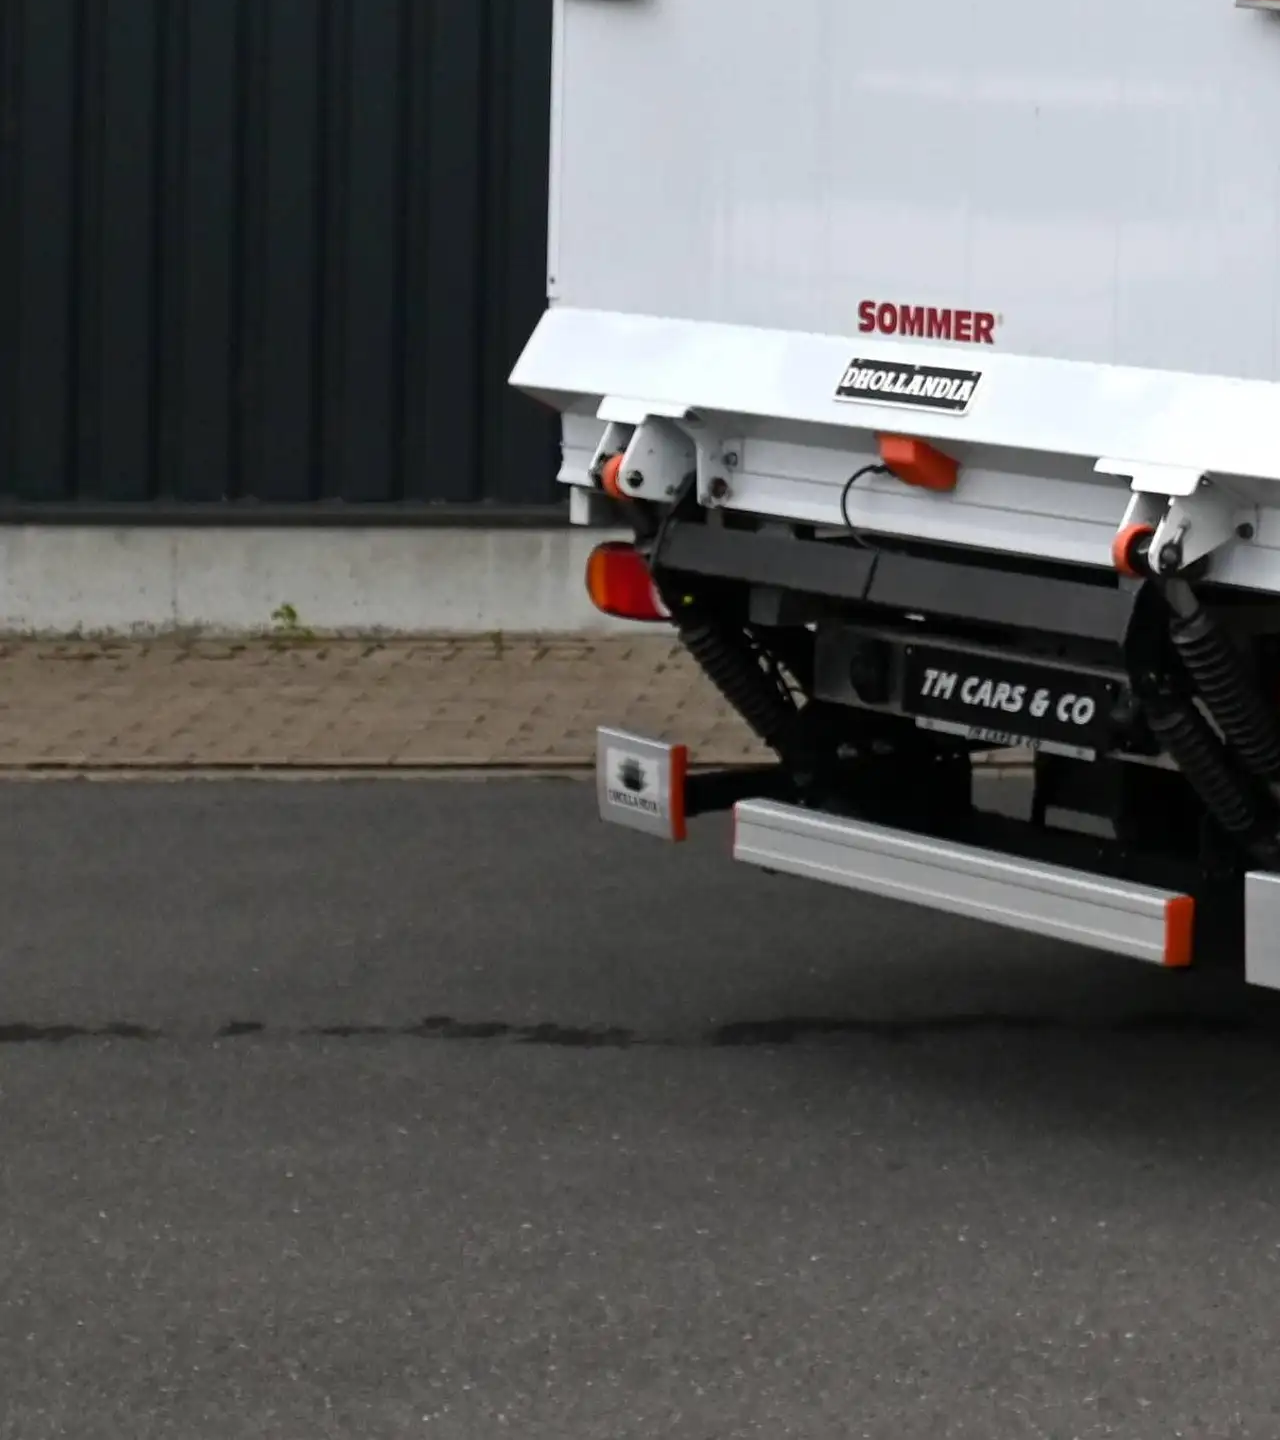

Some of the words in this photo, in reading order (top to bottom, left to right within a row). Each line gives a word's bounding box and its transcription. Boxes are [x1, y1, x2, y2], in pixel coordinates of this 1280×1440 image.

[857, 300, 995, 345] SOMMER
[840, 367, 974, 402] DHOLLANDIA
[920, 667, 958, 700] TM
[960, 675, 1027, 713] CARS
[1029, 688, 1050, 717] &
[1056, 693, 1096, 725] CO
